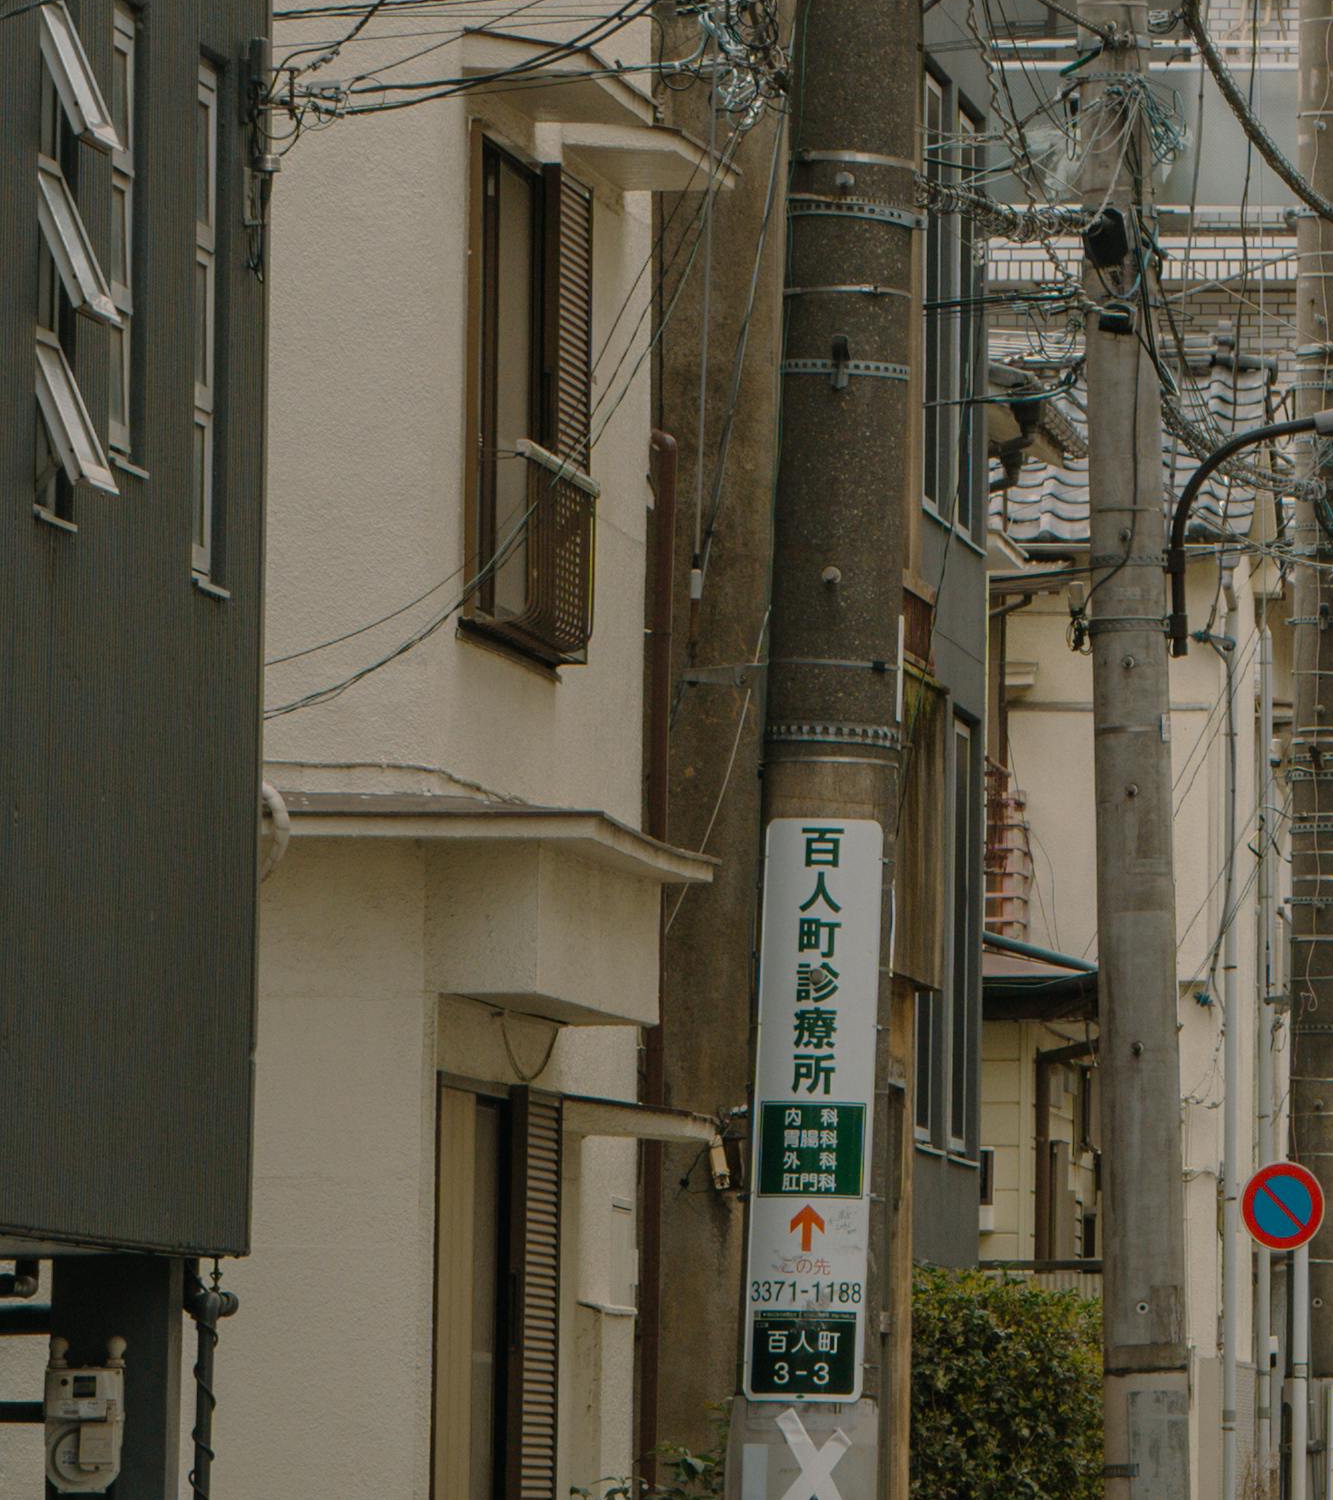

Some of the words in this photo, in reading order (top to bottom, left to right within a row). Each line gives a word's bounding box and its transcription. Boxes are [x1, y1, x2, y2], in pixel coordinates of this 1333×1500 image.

[791, 826, 845, 1095] 百人町診療所
[784, 1108, 839, 1127] 内科
[783, 1129, 839, 1148] 胃腸科
[782, 1151, 838, 1170] 外科
[781, 1173, 837, 1192] 肛門科
[780, 1258, 831, 1276] この先
[751, 1280, 862, 1304] 3371-1188
[767, 1329, 841, 1354] 百人町
[773, 1361, 831, 1386] 3-3
